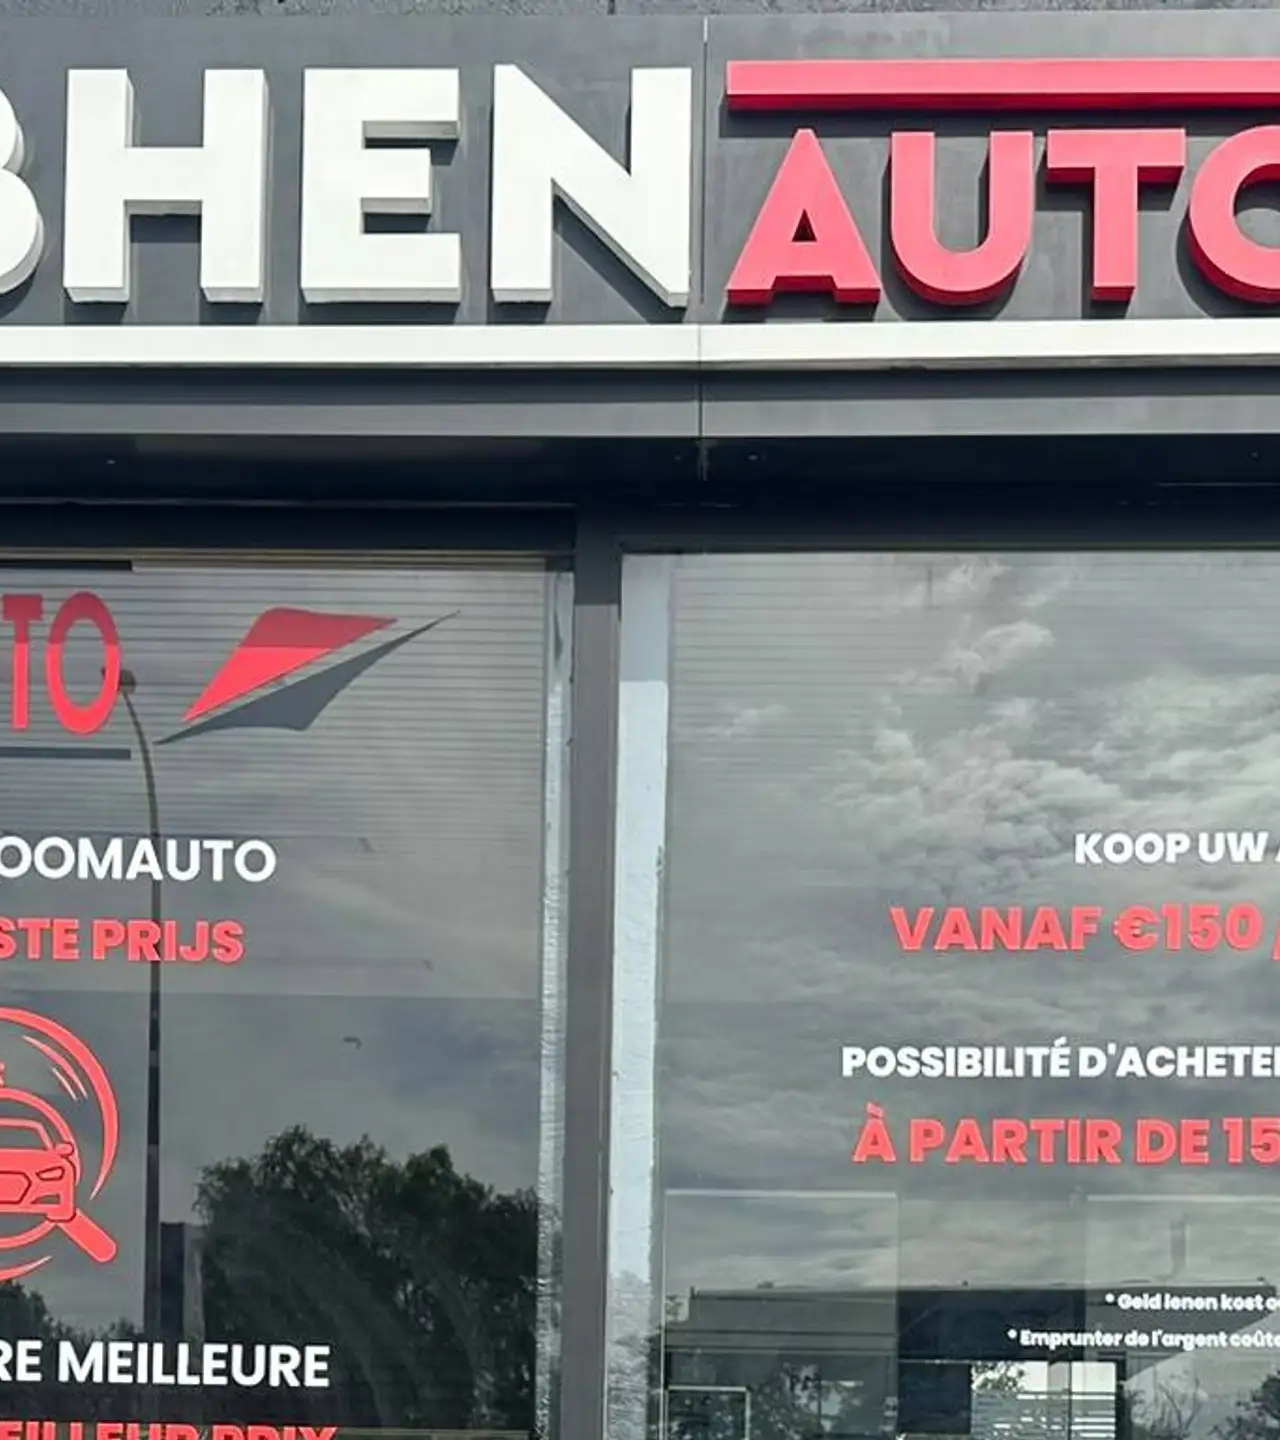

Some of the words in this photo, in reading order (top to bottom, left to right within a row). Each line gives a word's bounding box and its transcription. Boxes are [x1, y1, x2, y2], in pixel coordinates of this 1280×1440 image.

[1074, 831, 1191, 865] KOOP
[1197, 831, 1269, 864] UW
[91, 919, 246, 963] PRIJS
[890, 905, 1103, 952] VANAF
[1113, 904, 1264, 951] €150
[841, 1036, 1072, 1078] POSSIBILITÉ
[854, 1103, 898, 1163] À
[909, 1118, 1124, 1165] PARTIR
[1134, 1118, 1211, 1165] DE
[1118, 1293, 1161, 1310] Geld
[1221, 1294, 1263, 1311] kost
[1020, 1329, 1124, 1350] Emprunter
[1124, 1329, 1150, 1347] de
[1151, 1329, 1228, 1351] l'argent
[58, 1341, 331, 1387] MEILLEURE
